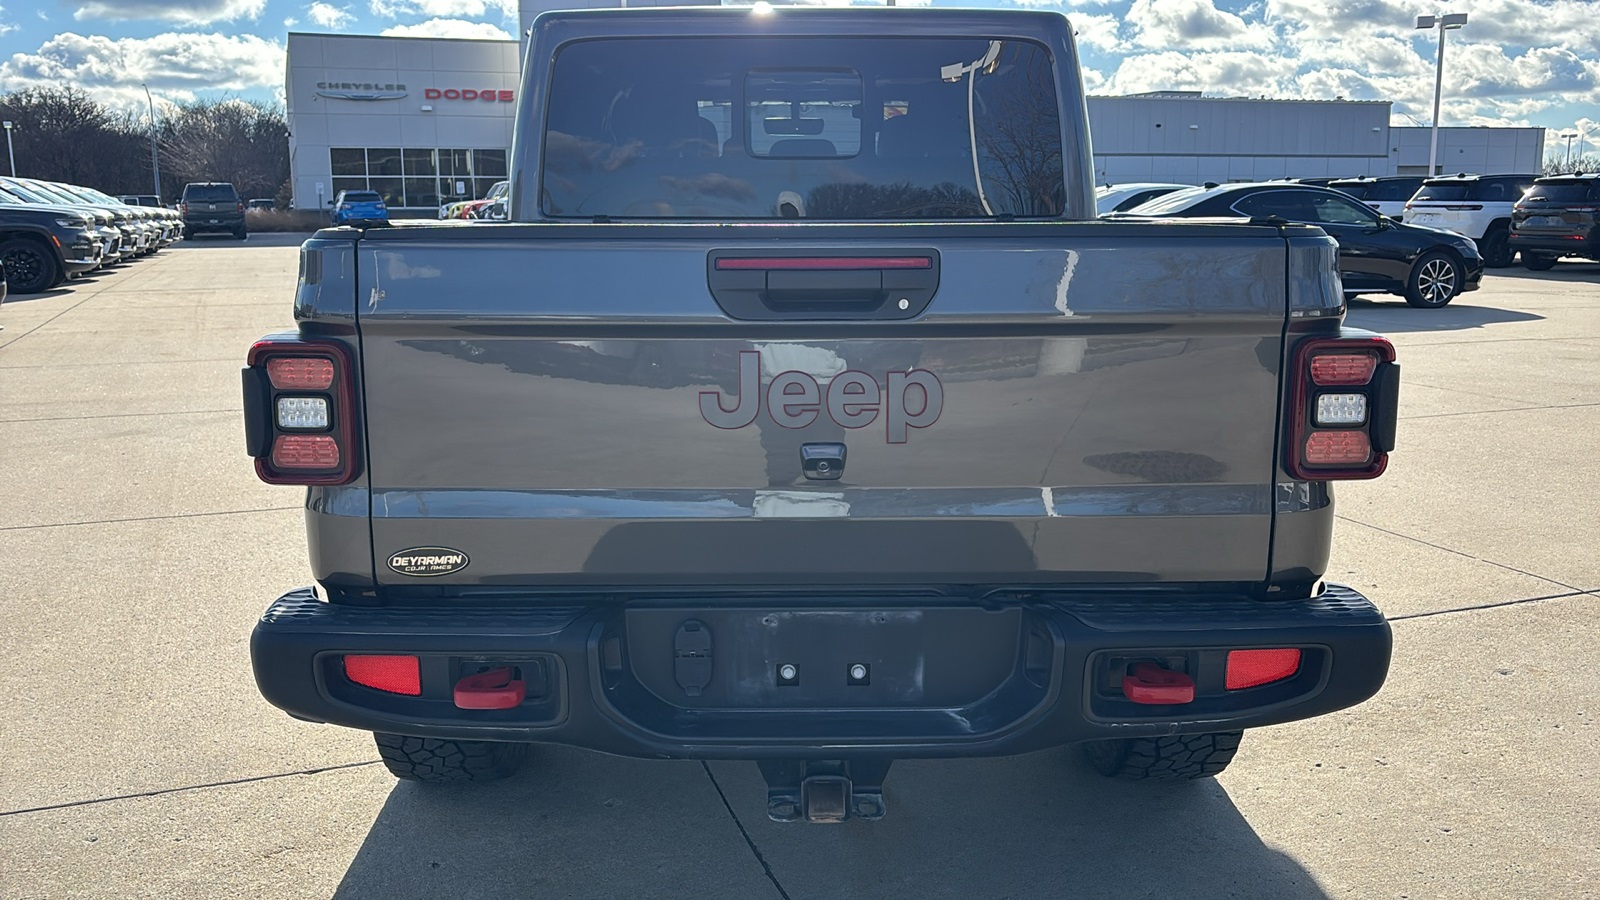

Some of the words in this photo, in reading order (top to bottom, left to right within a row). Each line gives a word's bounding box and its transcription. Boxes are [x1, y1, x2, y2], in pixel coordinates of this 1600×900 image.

[317, 82, 407, 92] CHRYSLER
[425, 88, 514, 102] DODGE
[699, 351, 943, 443] Jeep
[392, 555, 462, 567] DEYARMAN
